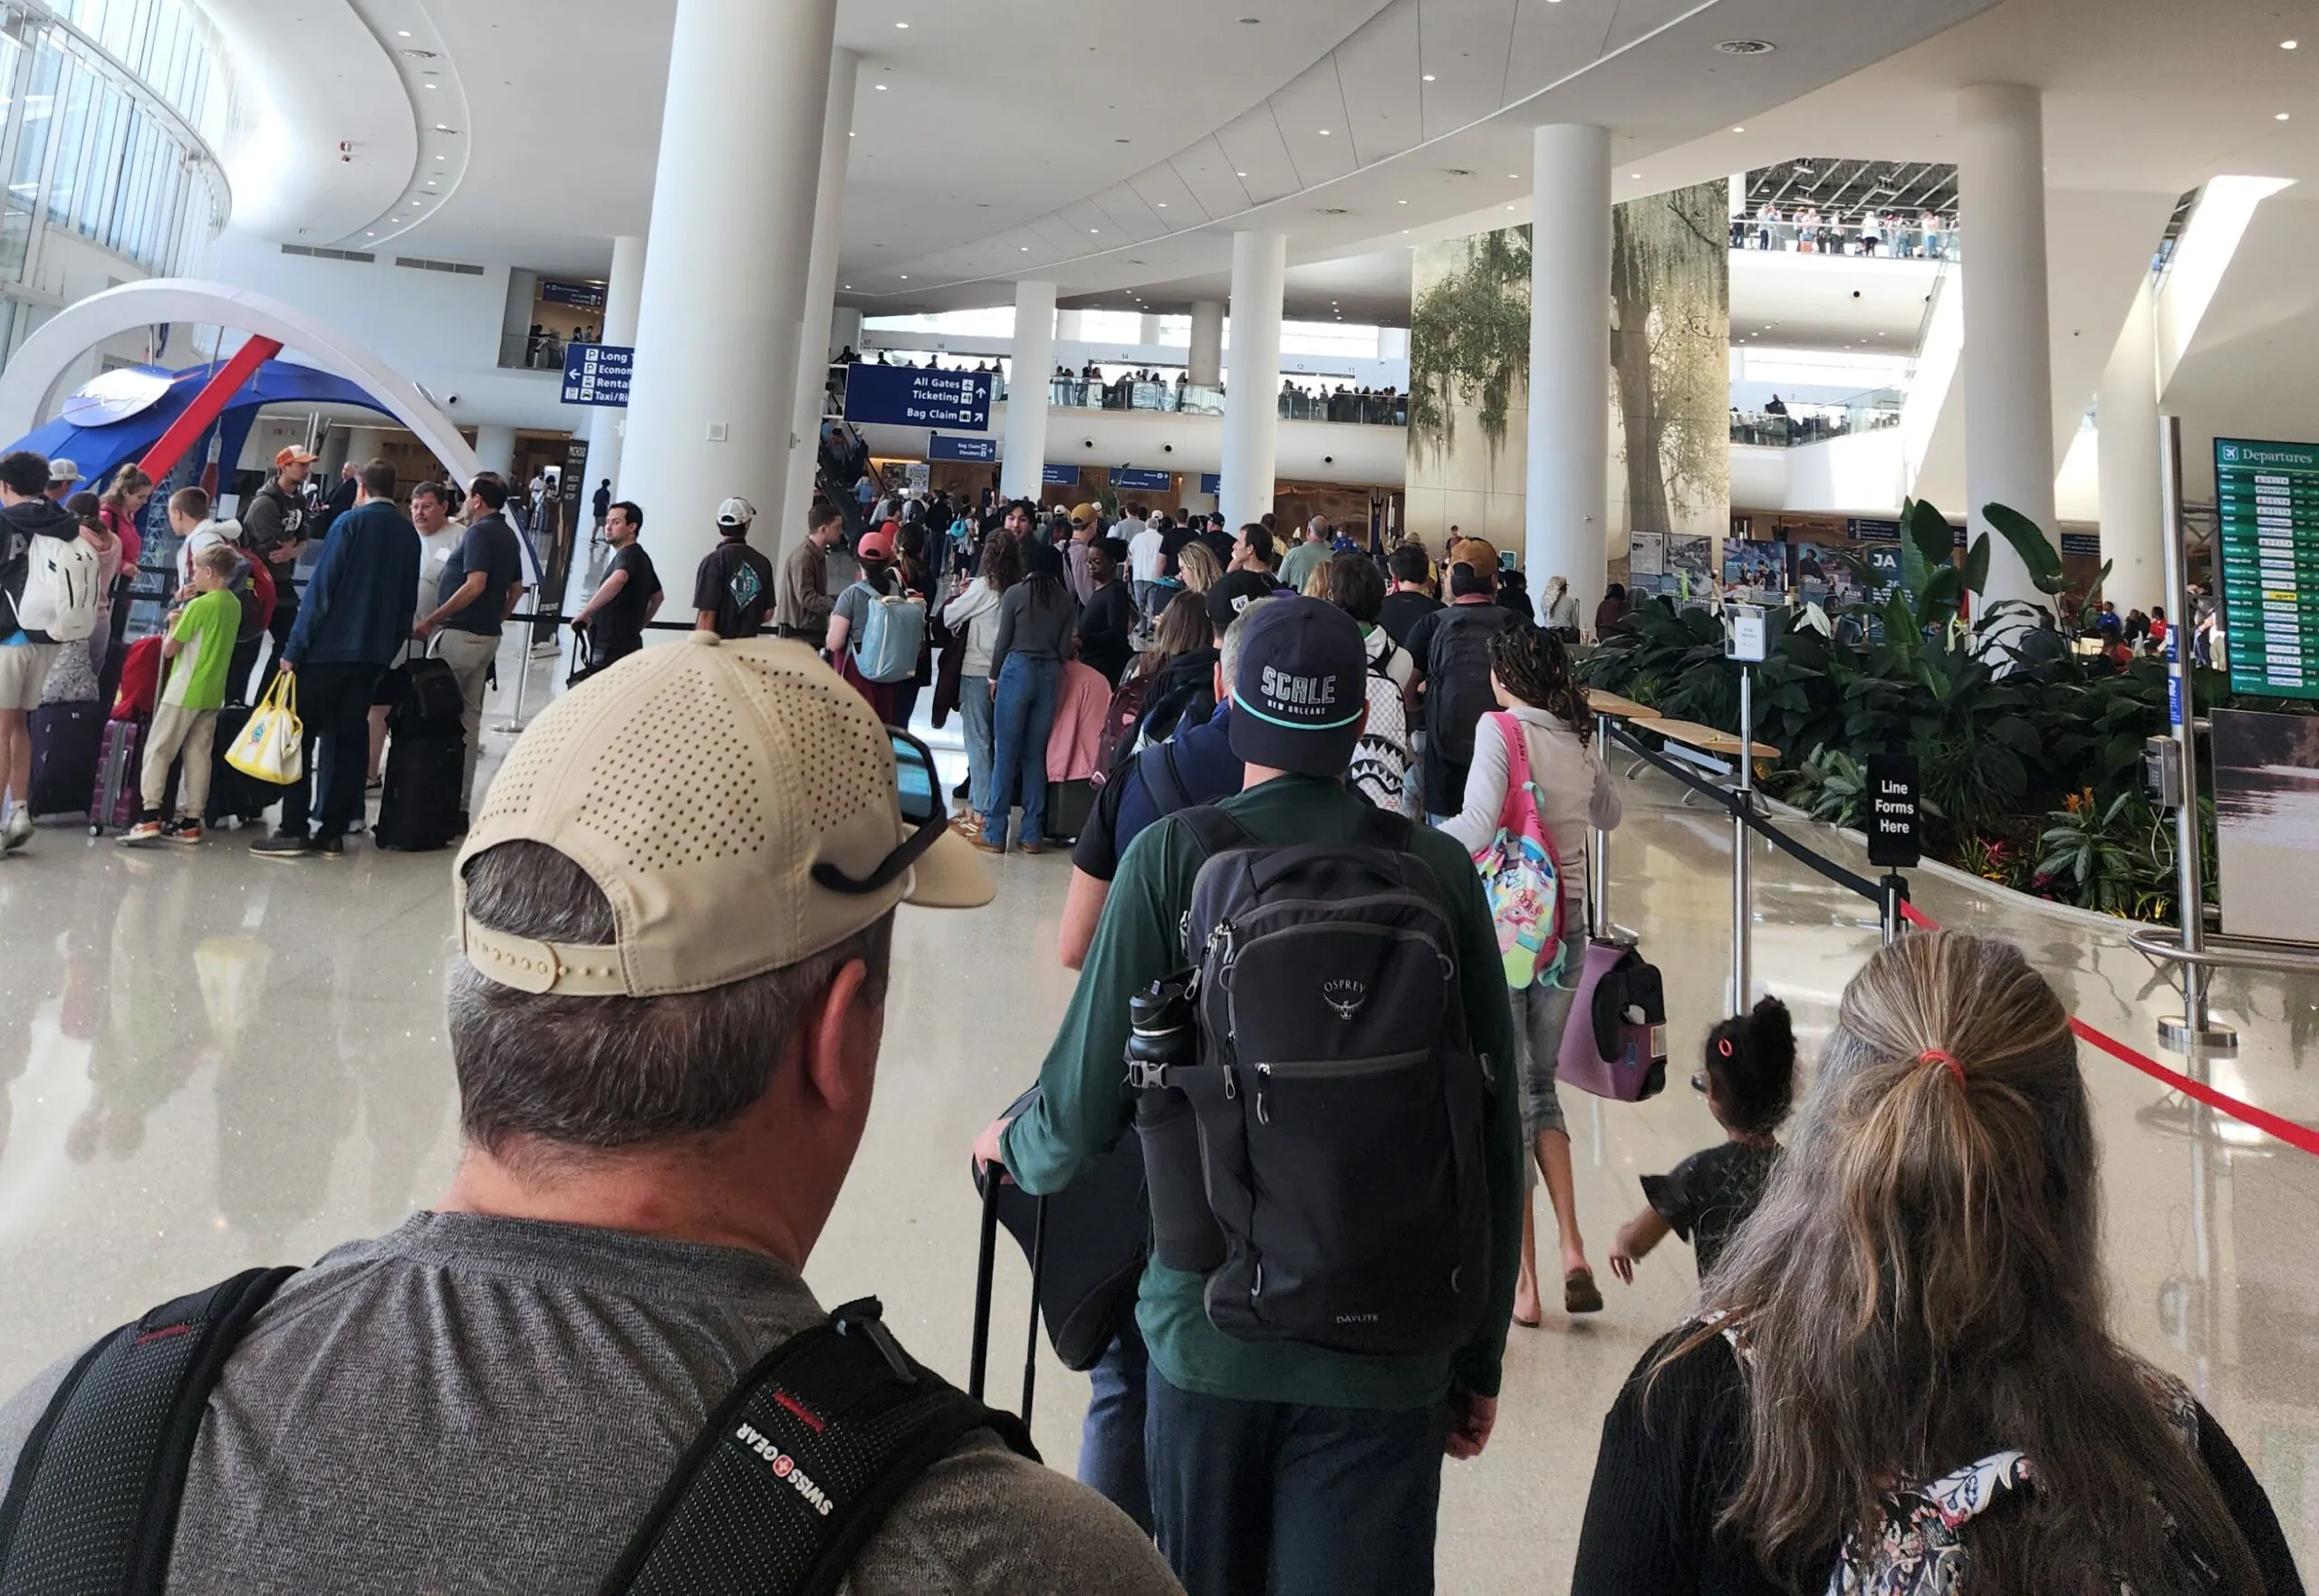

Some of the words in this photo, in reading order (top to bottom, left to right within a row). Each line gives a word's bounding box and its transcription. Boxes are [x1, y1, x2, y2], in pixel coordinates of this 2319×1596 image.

[601, 351, 628, 363] Long
[913, 377, 929, 387] All
[931, 378, 960, 389] Gates
[912, 389, 959, 404] Ticketing
[907, 408, 927, 419] Bag
[929, 409, 957, 420] Claim
[2242, 447, 2313, 465] Departures
[1260, 665, 1336, 705] SCALE
[1267, 699, 1285, 711] NEW
[1288, 704, 1327, 716] ORLEANS
[1881, 779, 1909, 794] Line
[1875, 799, 1914, 814] Forms
[1880, 819, 1910, 833] Here
[1324, 978, 1366, 993] OSPREY
[1336, 1313, 1379, 1324] DAYLITE
